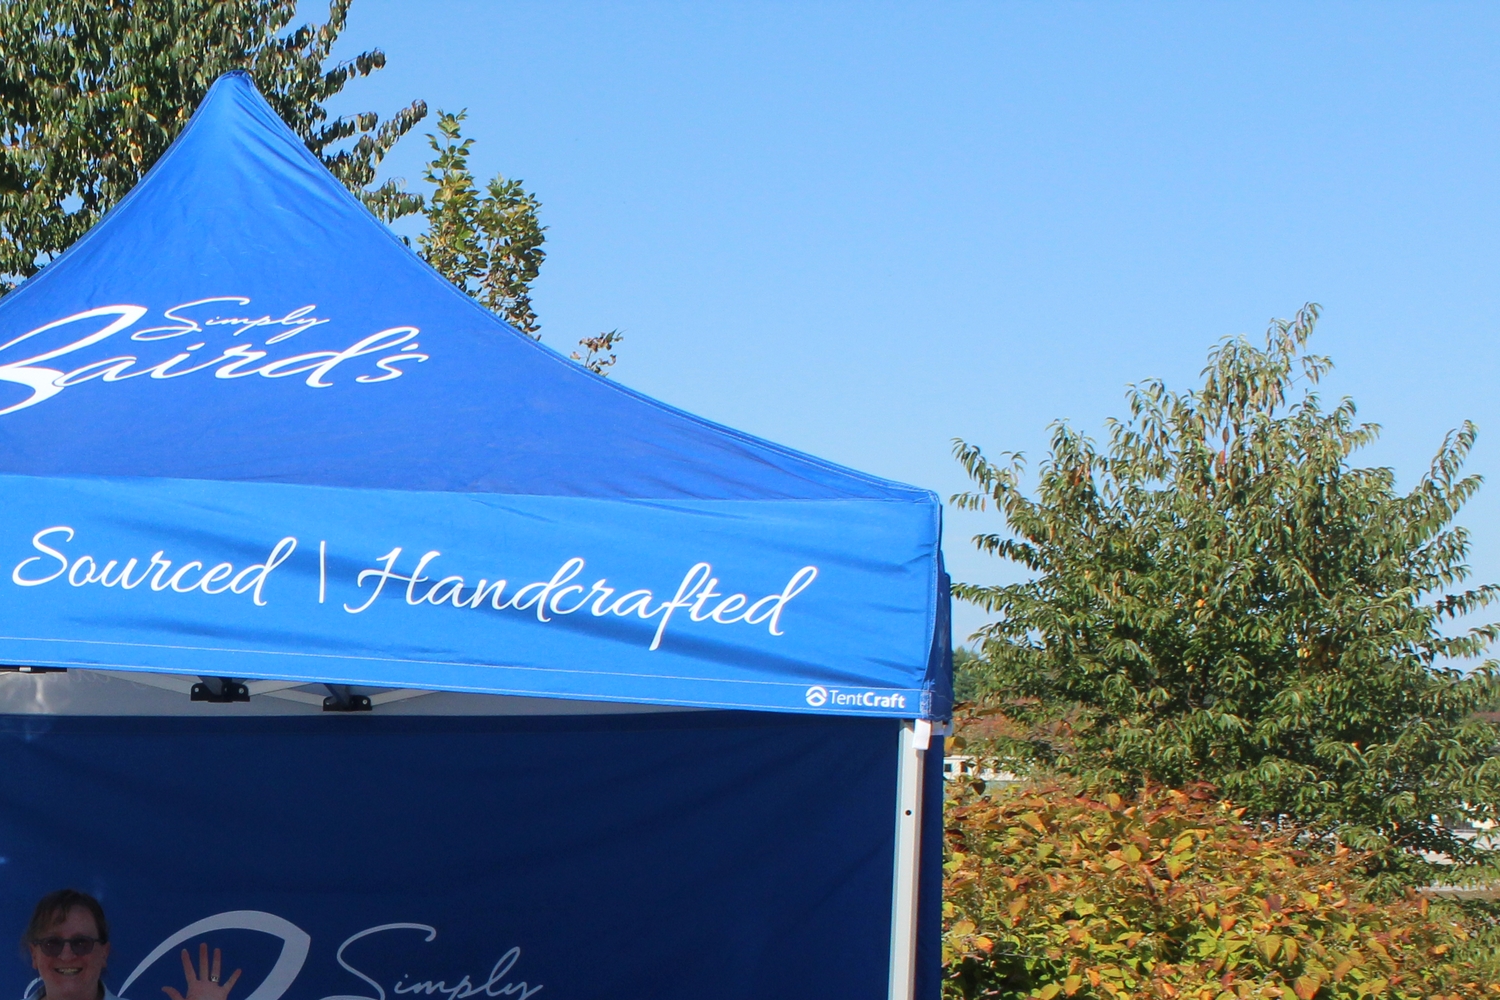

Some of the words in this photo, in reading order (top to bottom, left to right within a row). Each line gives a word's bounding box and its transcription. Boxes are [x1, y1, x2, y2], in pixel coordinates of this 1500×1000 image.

[131, 297, 330, 345] Simply
[12, 526, 297, 606] Sourced
[343, 547, 818, 651] Handcrafted
[829, 690, 905, 709] TentCraft
